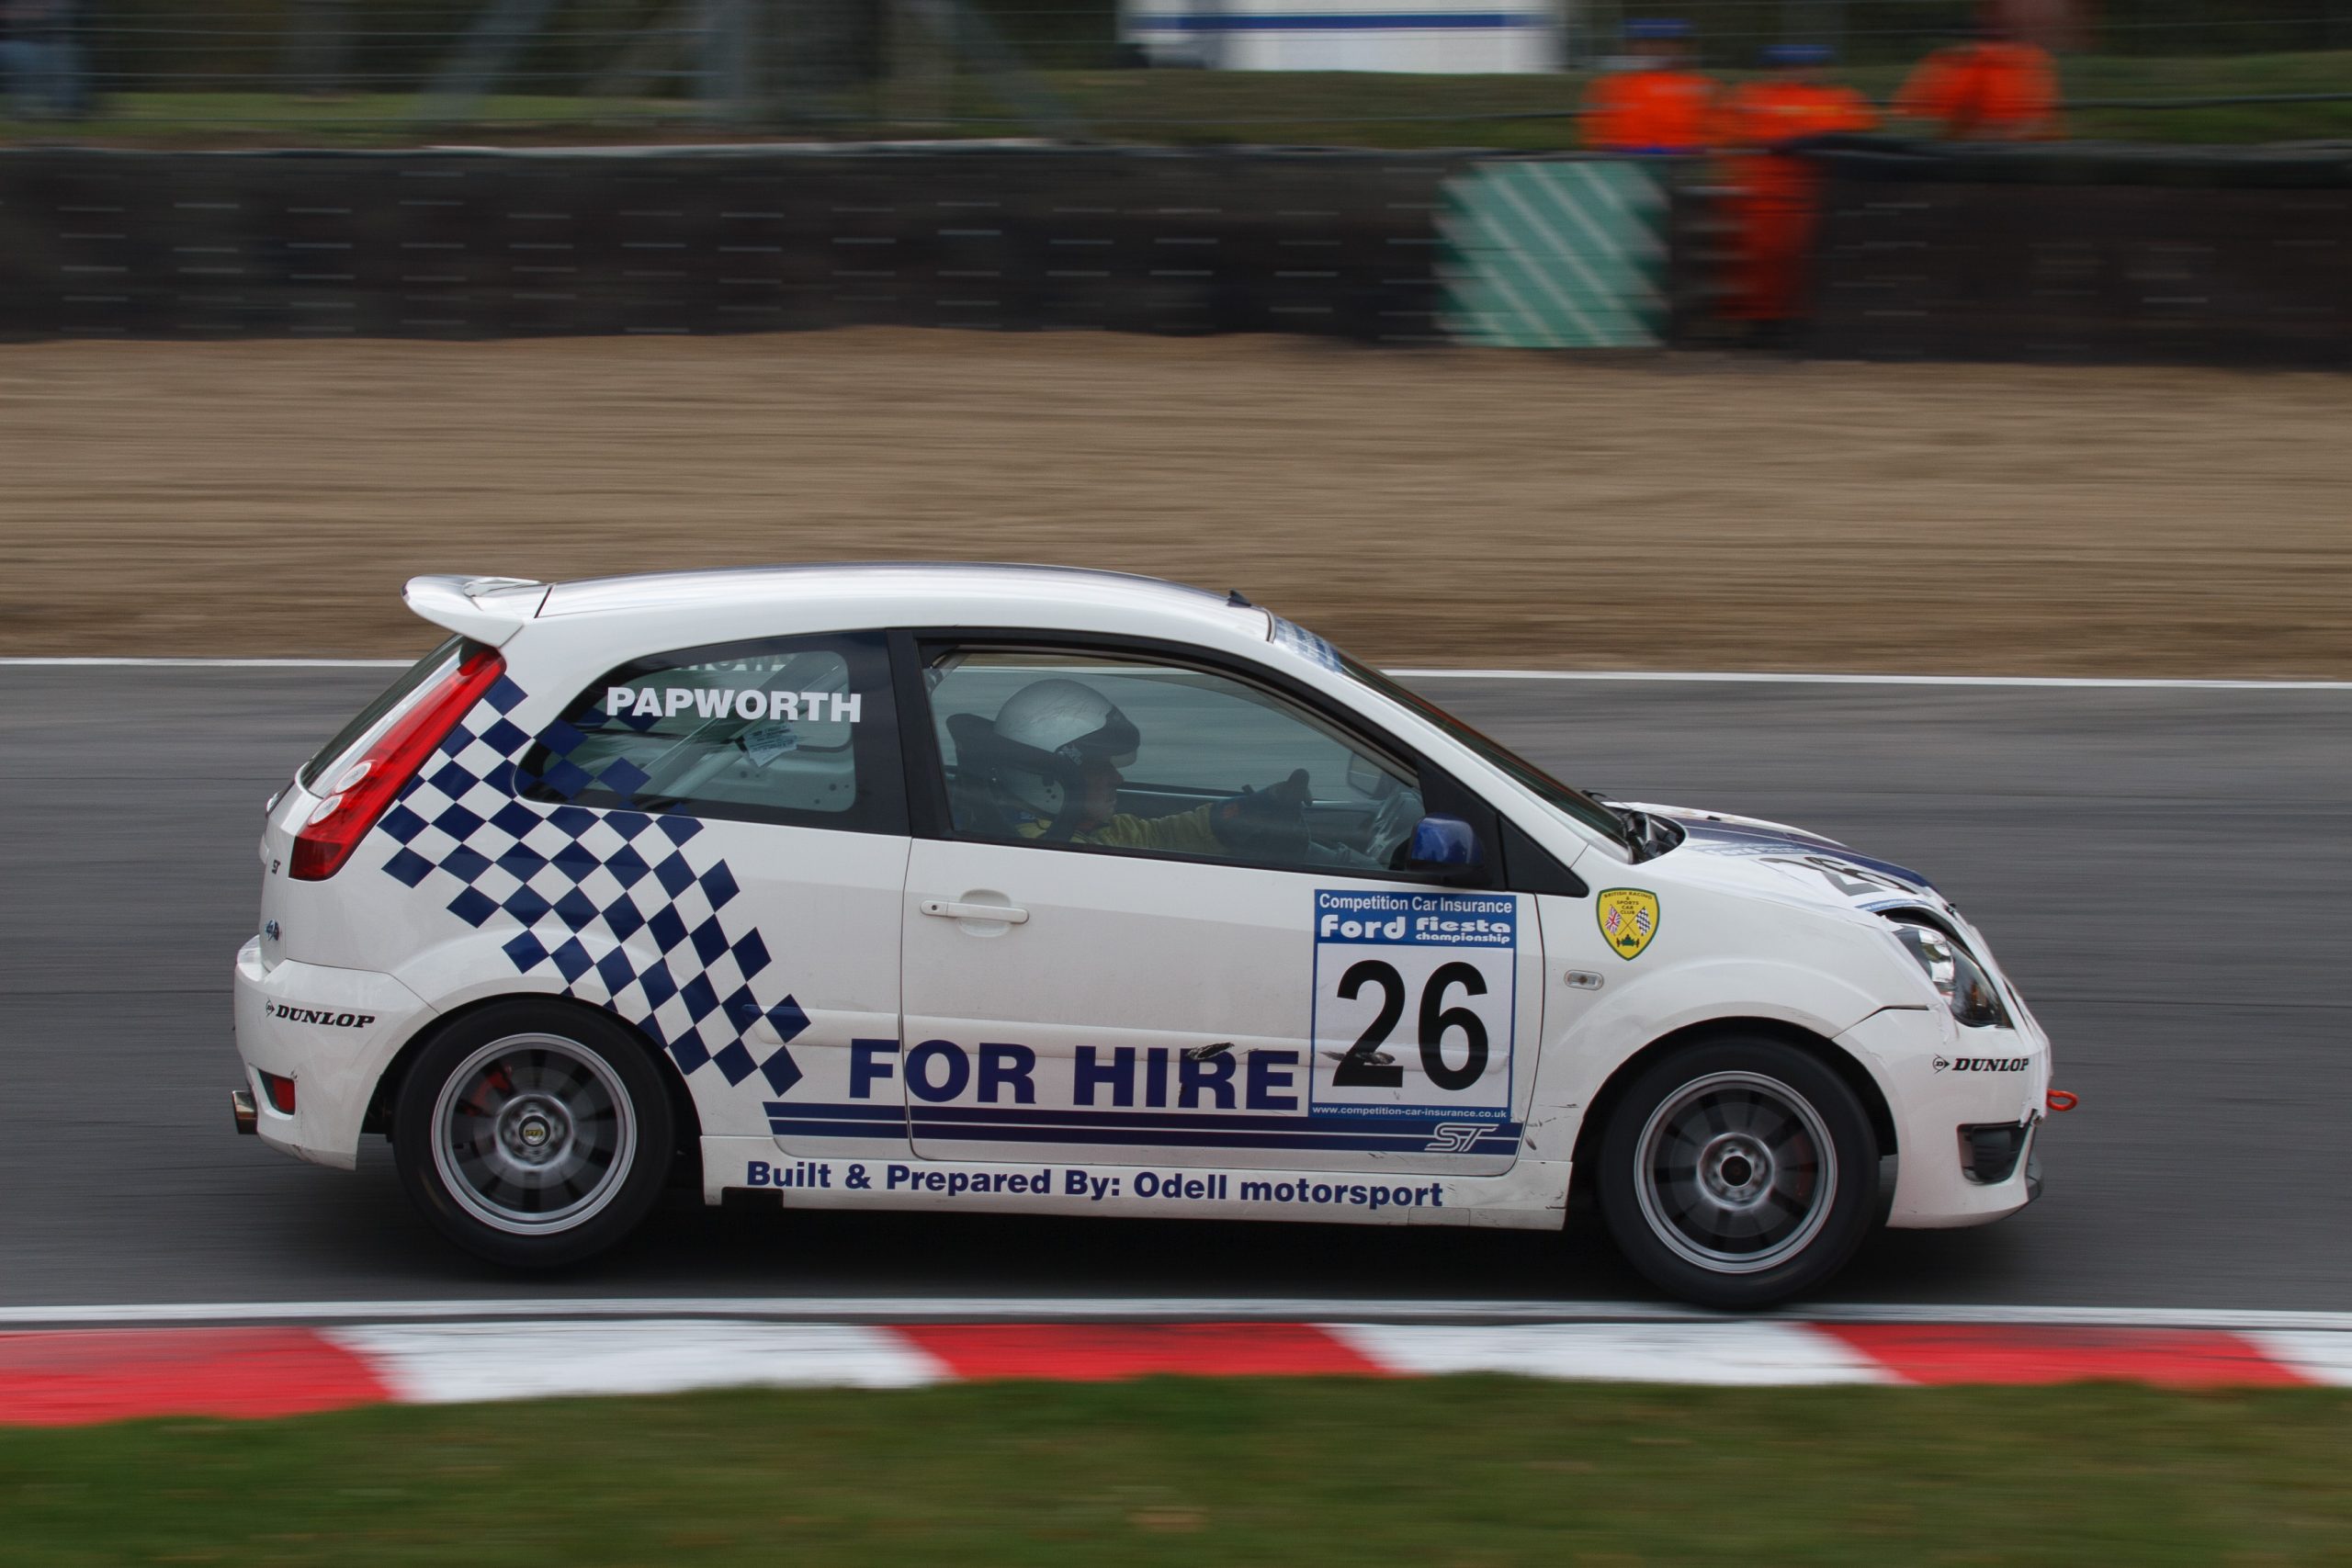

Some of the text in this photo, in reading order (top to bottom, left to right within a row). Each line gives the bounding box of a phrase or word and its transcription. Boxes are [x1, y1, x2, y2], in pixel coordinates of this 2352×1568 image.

[606, 686, 862, 723] PAPWORTH
[1319, 893, 1512, 913] Competition Car Insurance
[1416, 916, 1511, 933] fiesta
[1415, 931, 1510, 944] championship
[276, 1004, 376, 1028] DUNLOP
[1332, 959, 1488, 1091] 26
[849, 1038, 1300, 1111] FOR HIRE
[1951, 1057, 2030, 1072] DUNLOP
[1312, 1106, 1507, 1119] www.competition-car-insurance.co.uk
[1424, 1122, 1500, 1153] ST
[746, 1160, 1444, 1211] Built & Prepared By: Odell motorsport
